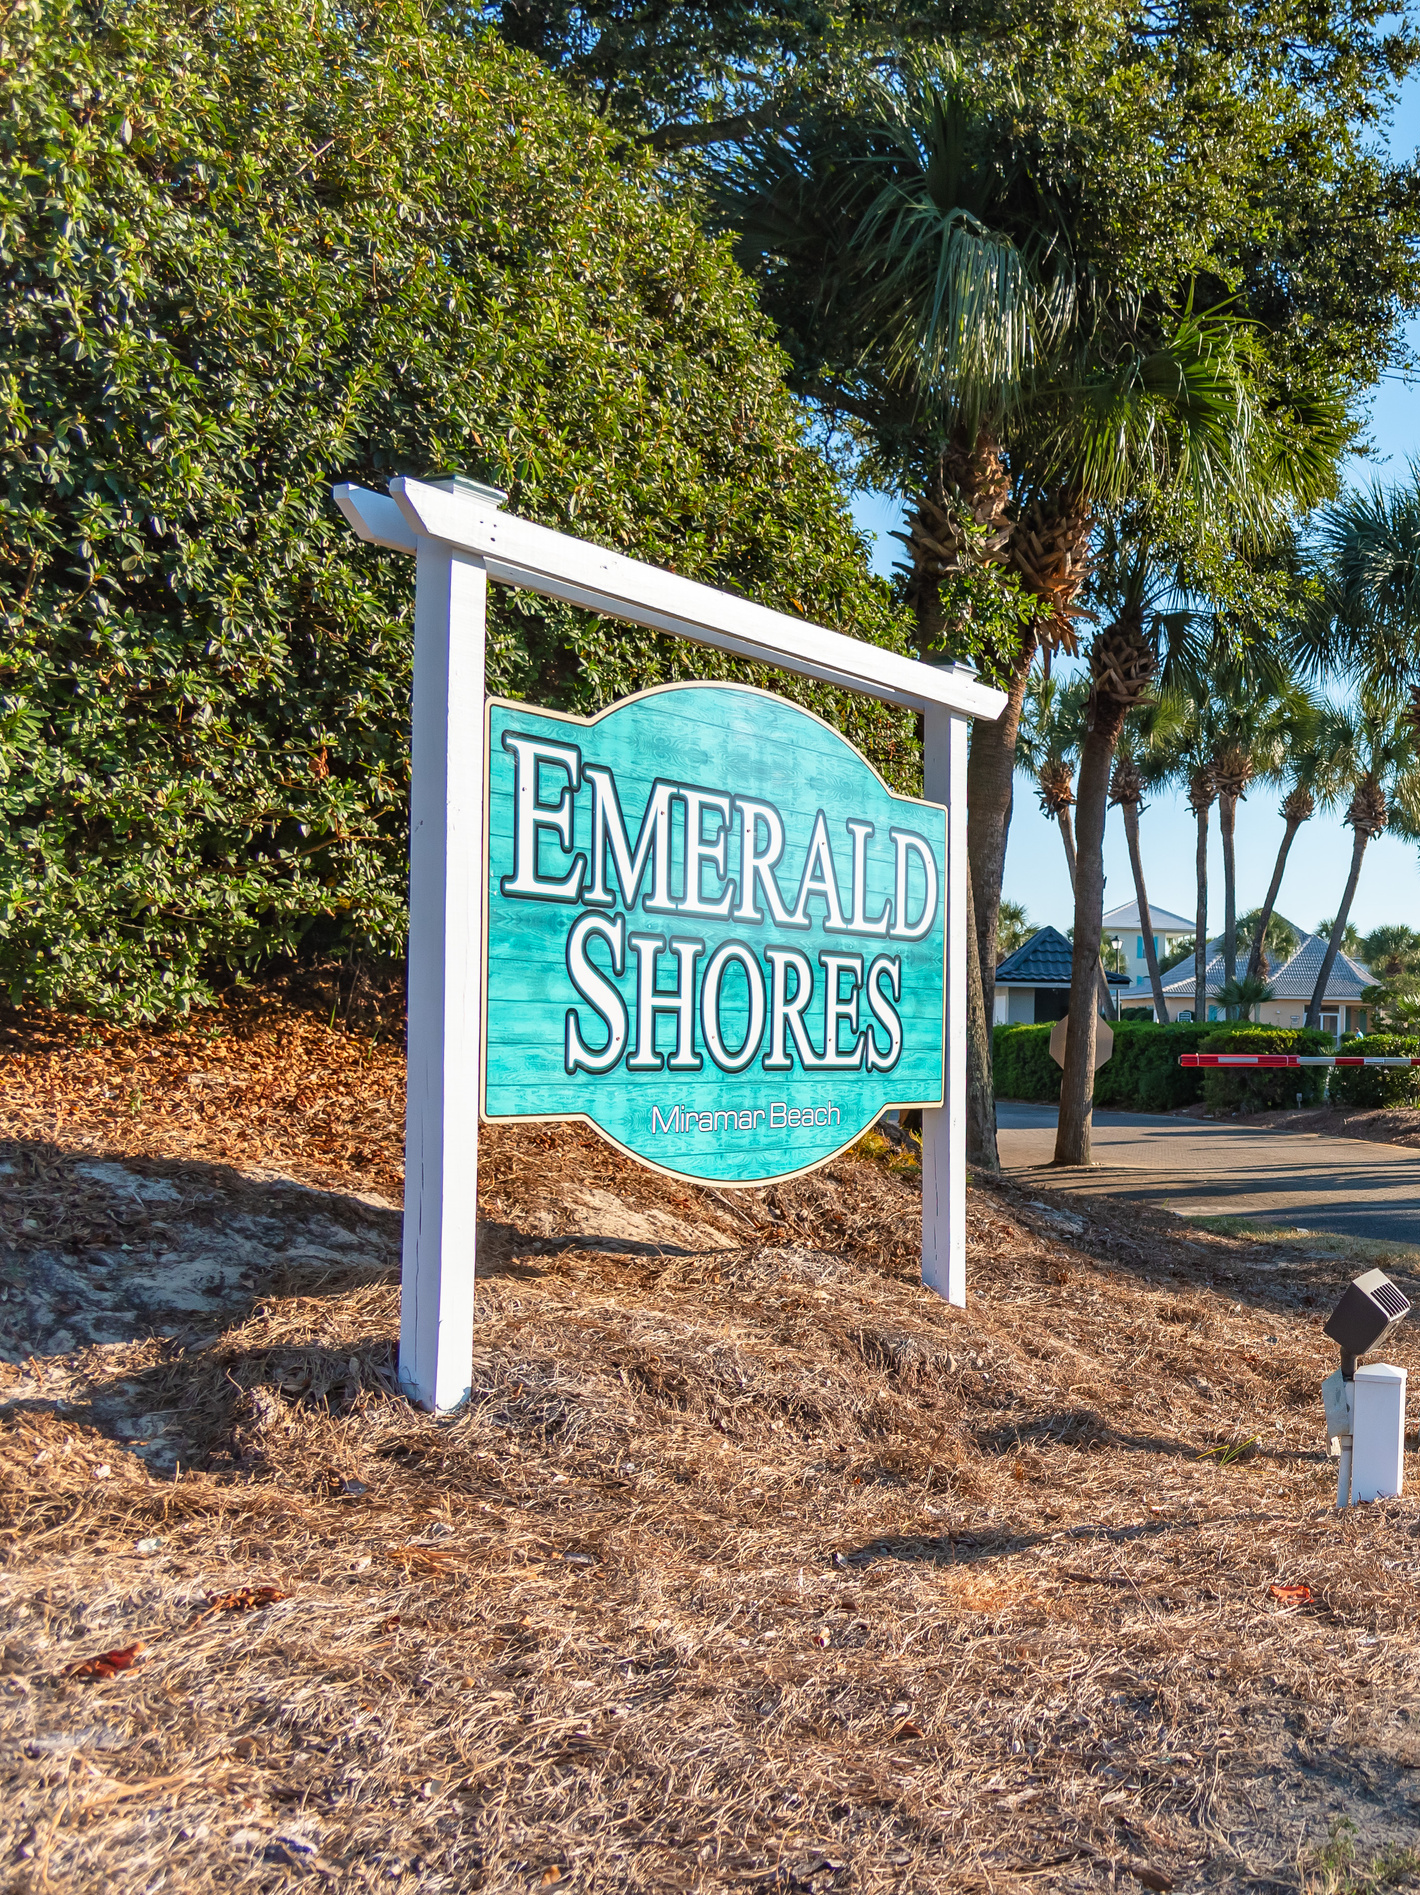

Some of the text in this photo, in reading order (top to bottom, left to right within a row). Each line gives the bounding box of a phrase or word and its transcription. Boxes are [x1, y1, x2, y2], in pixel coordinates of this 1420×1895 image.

[501, 730, 941, 941] EMERALD
[565, 909, 903, 1075] SHORES
[651, 1100, 841, 1134] Miramar Beach
